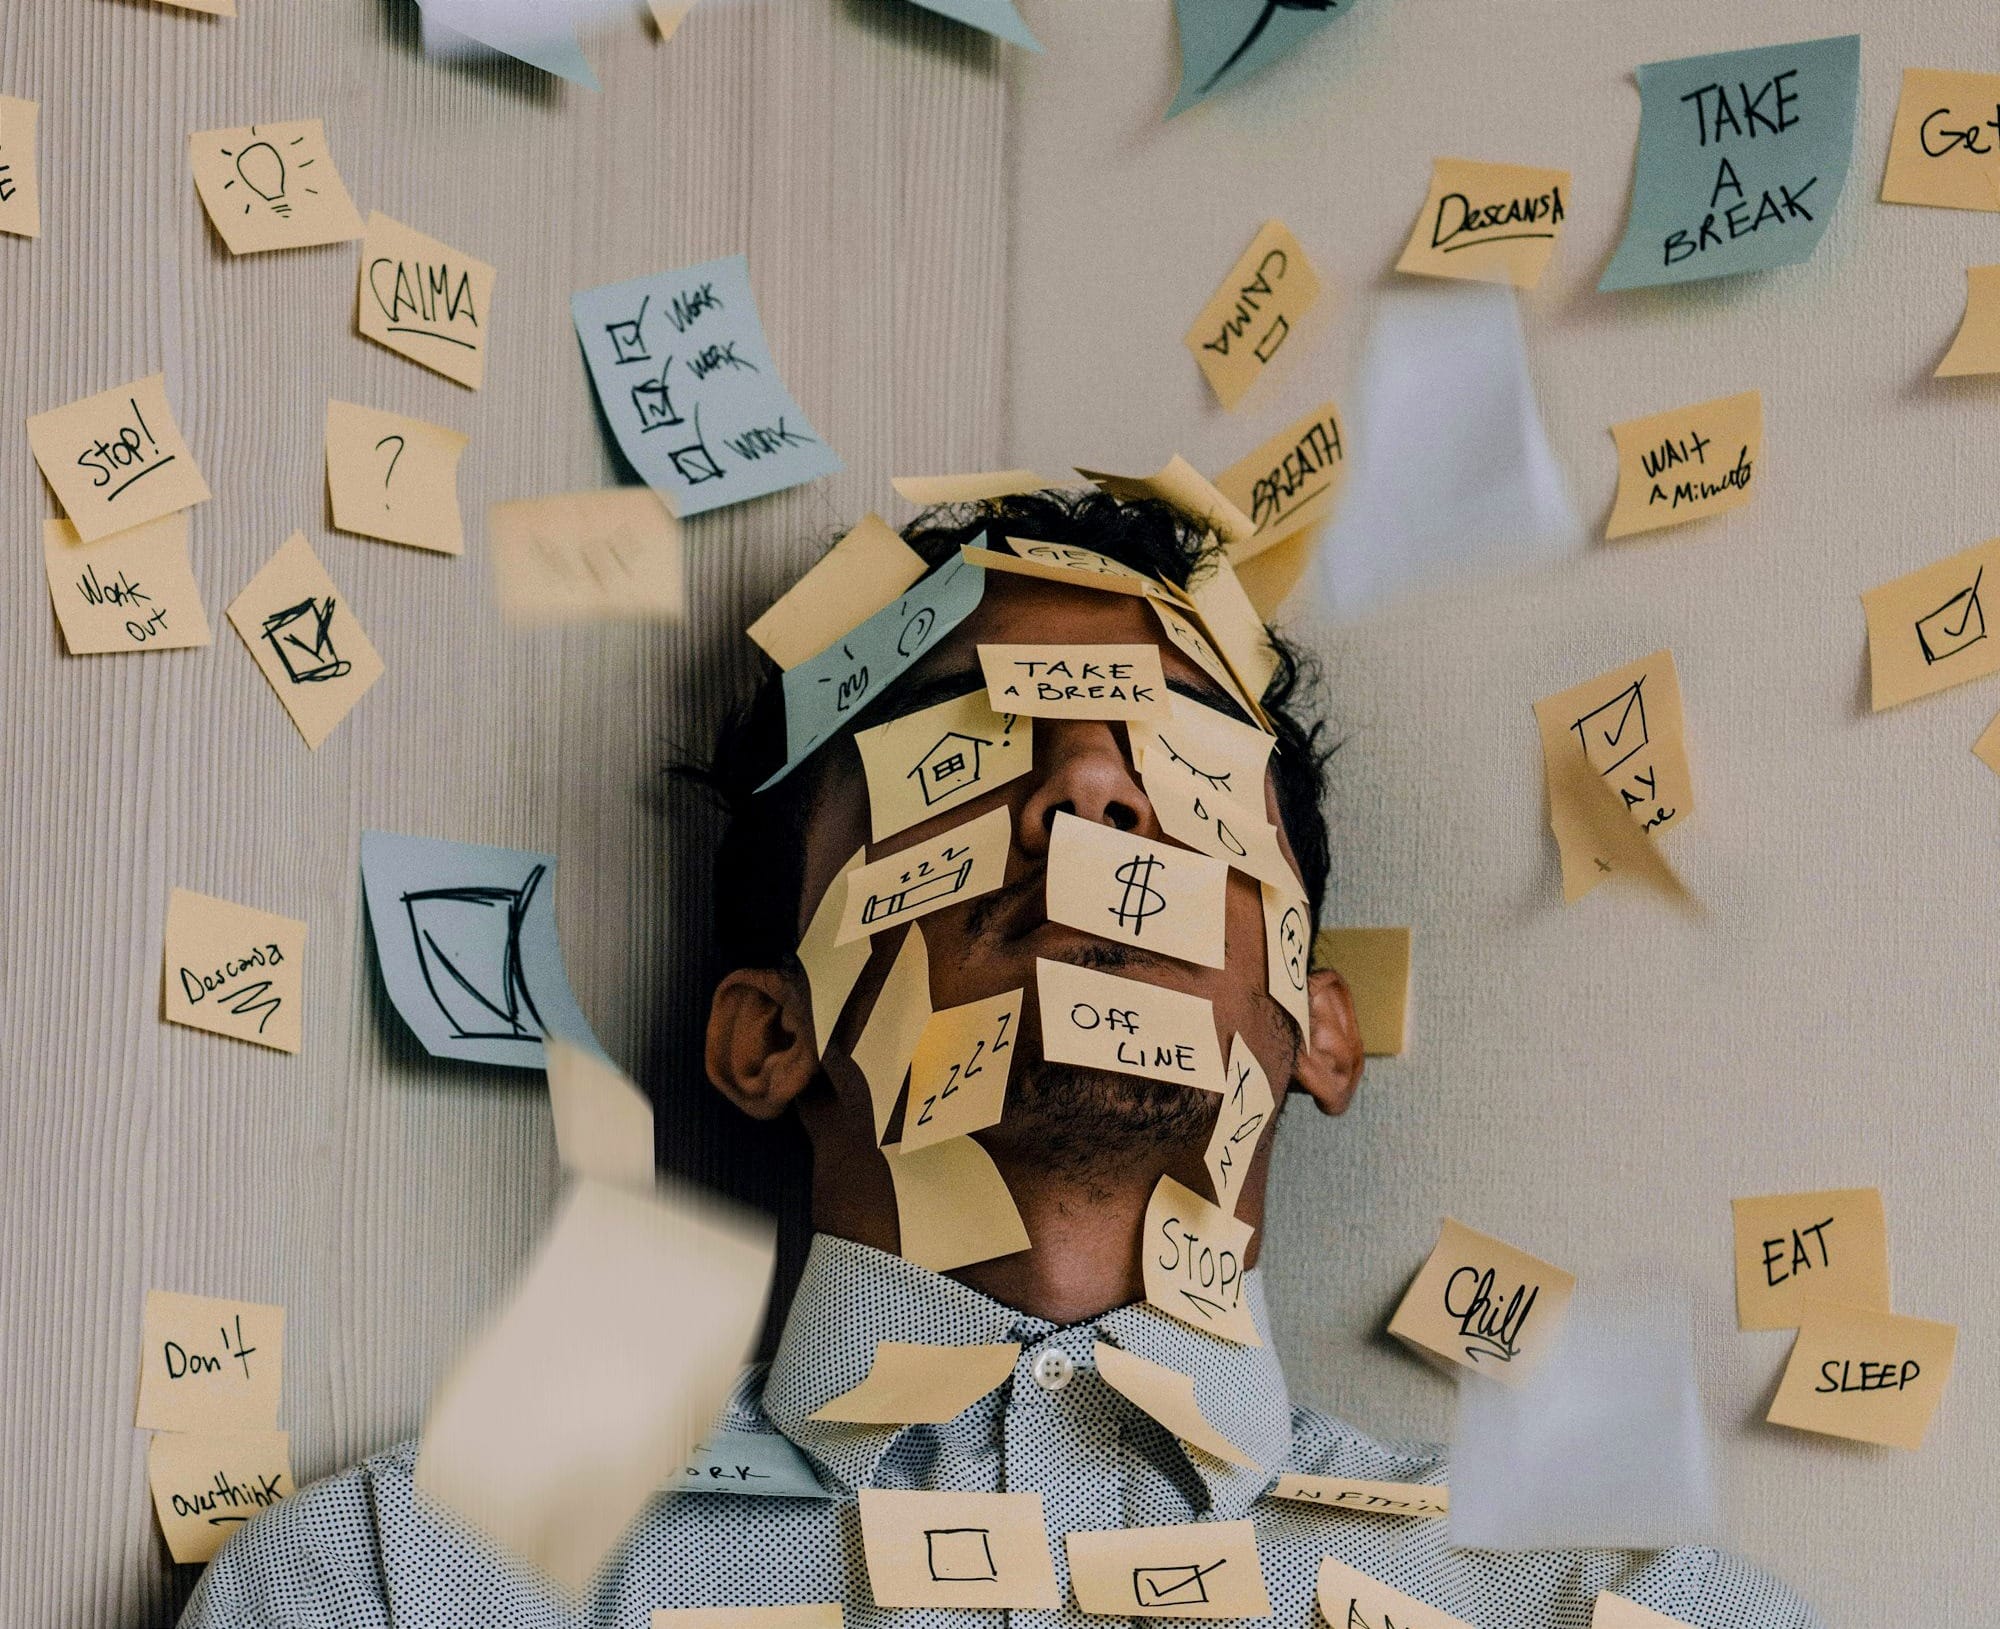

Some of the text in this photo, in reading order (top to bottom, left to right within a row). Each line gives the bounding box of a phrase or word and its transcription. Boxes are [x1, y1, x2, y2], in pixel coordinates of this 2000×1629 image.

[1680, 69, 1800, 146] TAKE
[1711, 158, 1744, 208] A
[1664, 176, 1818, 267] BREAK
[370, 258, 478, 328] CALMA
[1251, 416, 1343, 537] BREATH
[1014, 661, 1134, 679] TAKE
[1037, 682, 1155, 702] BREAK
[1117, 1042, 1196, 1071] LINE
[1763, 1217, 1834, 1286] EAT
[164, 1314, 257, 1380] Don't
[1815, 1360, 1921, 1393] SLEEP
